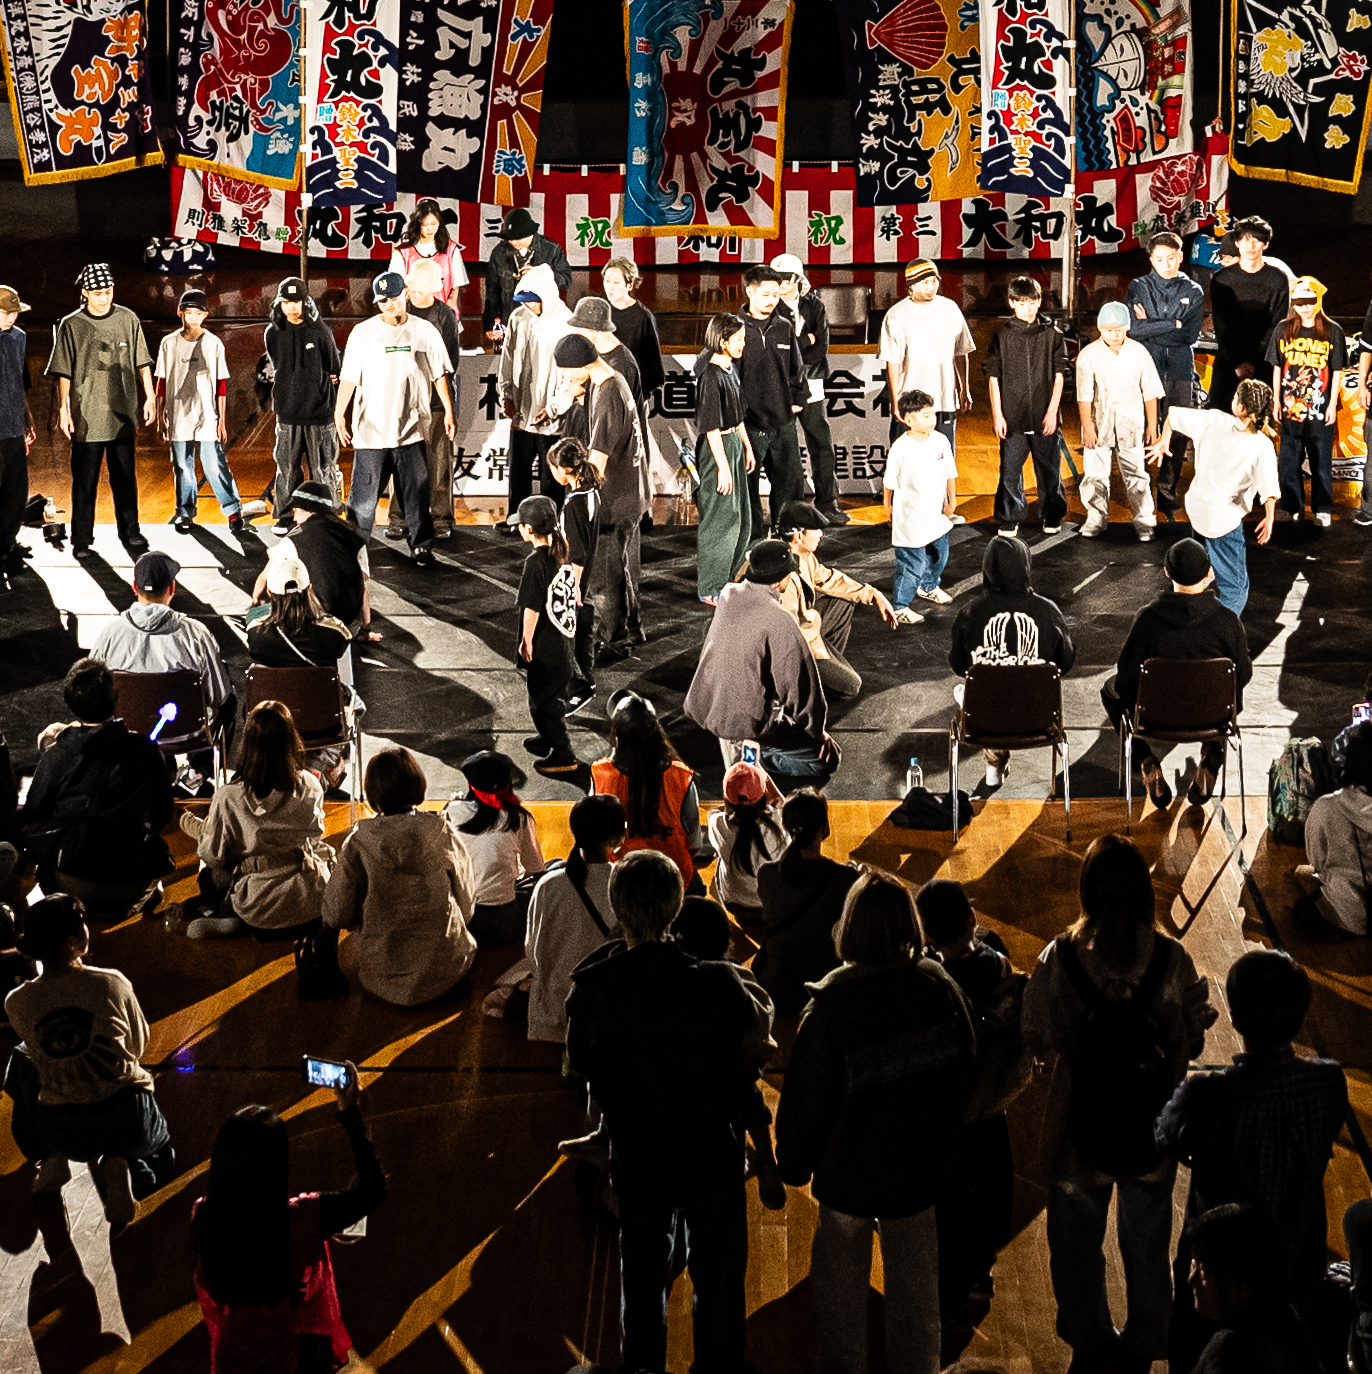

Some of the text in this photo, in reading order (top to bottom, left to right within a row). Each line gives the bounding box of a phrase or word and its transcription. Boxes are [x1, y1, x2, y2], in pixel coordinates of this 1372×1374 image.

[509, 14, 543, 45] 大
[54, 10, 145, 157] 新宝丸
[396, 30, 423, 151] 小林民雄
[420, 6, 492, 173] 広漁丸
[492, 82, 519, 107] 祝
[205, 94, 251, 144] 雲
[266, 100, 300, 157] 大漁
[669, 96, 697, 128] 祝
[705, 45, 769, 214] 丸宝丸
[1011, 90, 1035, 177] 鈴木聖二
[335, 102, 359, 189] 鈴木聖二
[492, 147, 529, 177] 漁
[575, 216, 613, 249] 祝
[810, 212, 846, 247] 祝
[878, 214, 938, 241] 第三
[960, 193, 1127, 252] 大和丸
